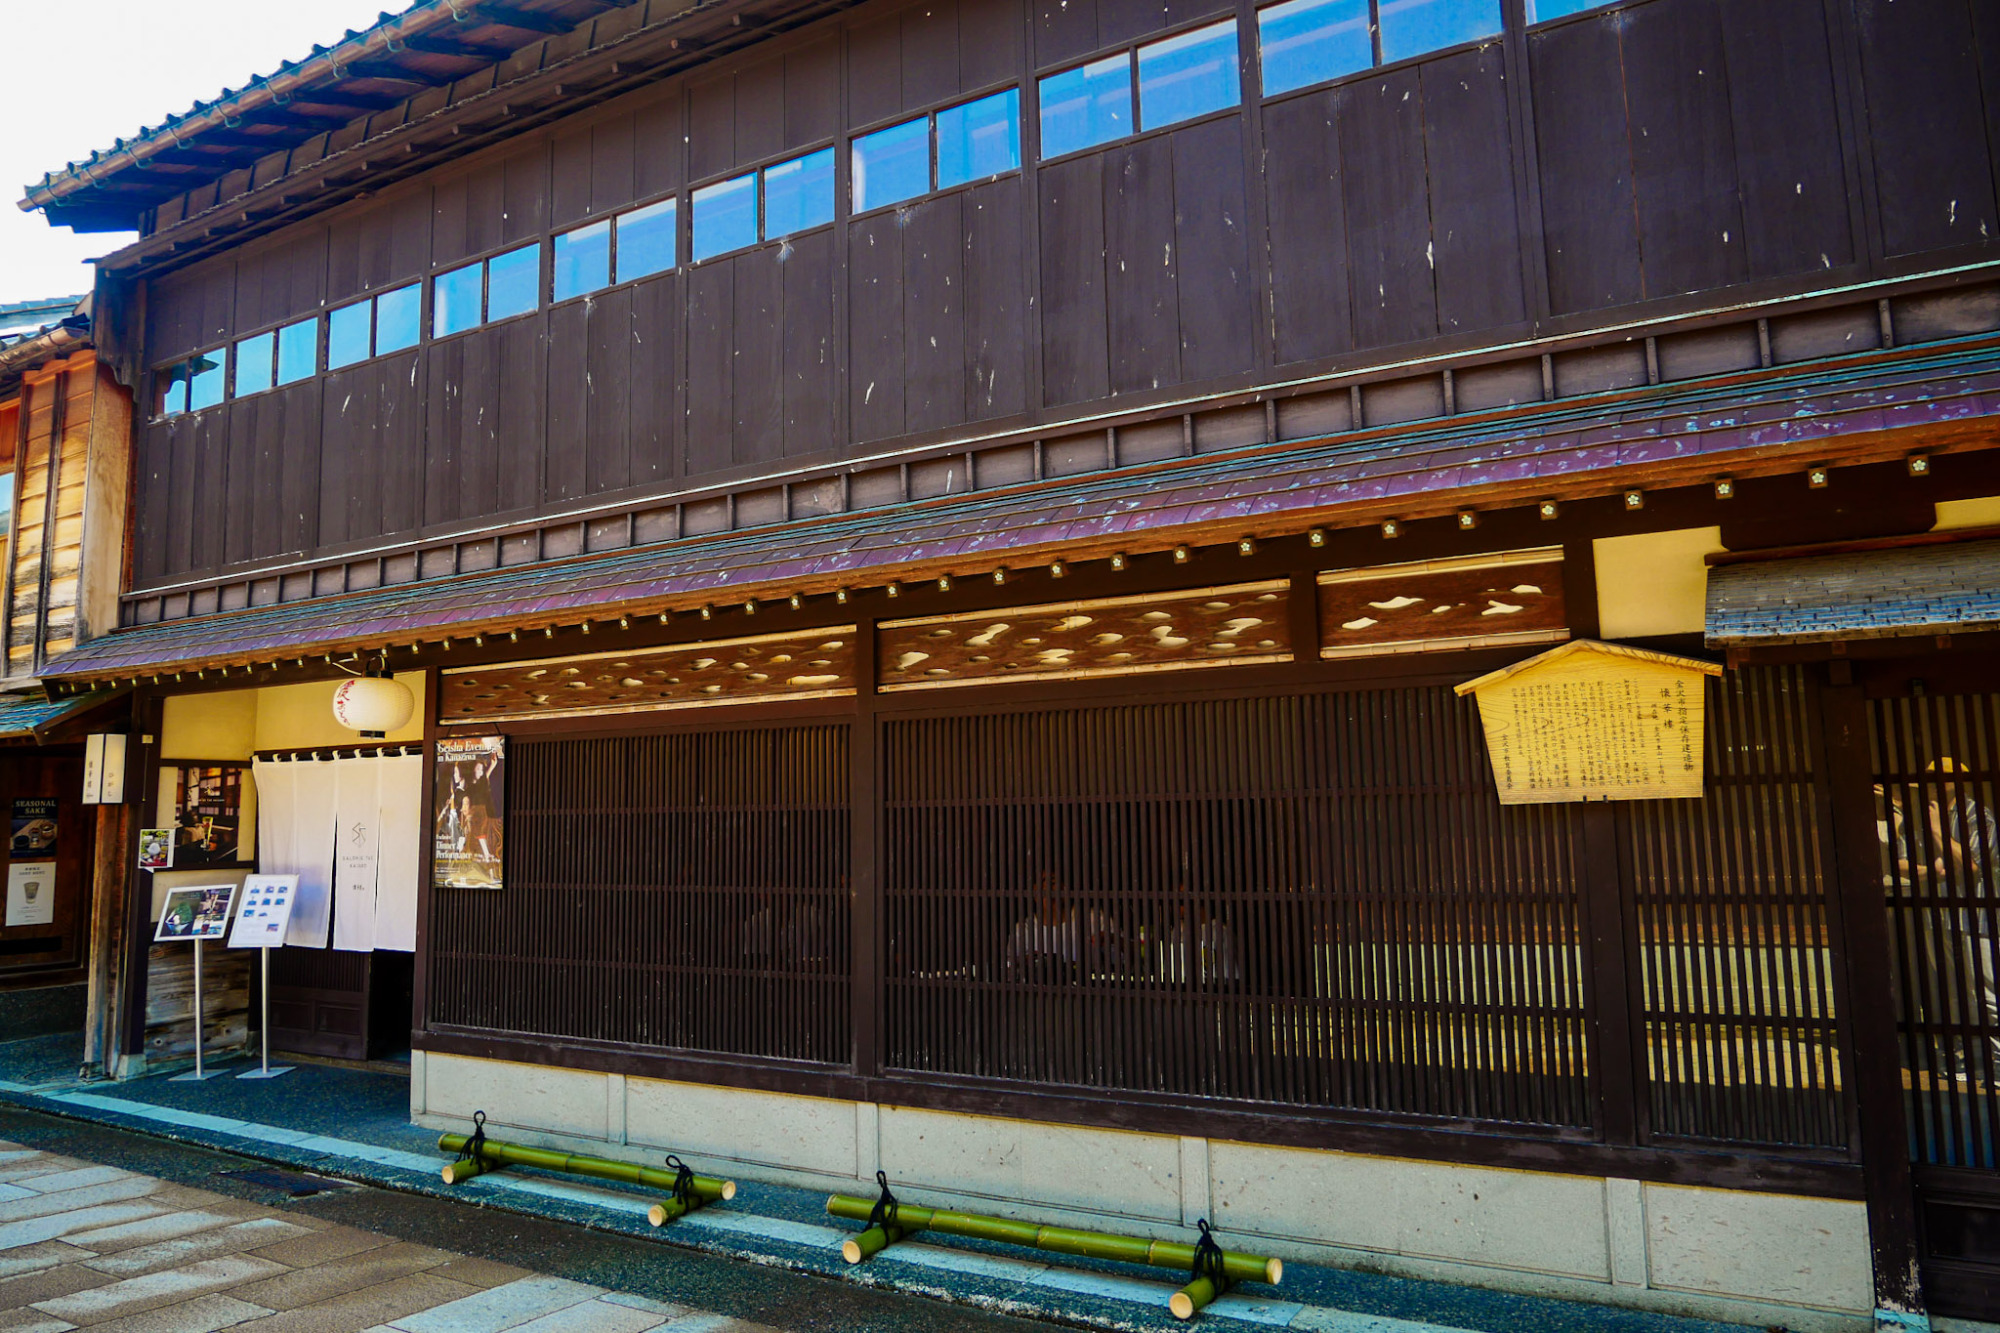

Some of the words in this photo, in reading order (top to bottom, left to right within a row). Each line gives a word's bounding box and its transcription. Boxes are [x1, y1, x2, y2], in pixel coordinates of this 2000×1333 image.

[1674, 680, 1694, 771] 金沢市指定保存建造物
[436, 741, 464, 753] Geisha
[445, 753, 476, 762] Kanazawa
[436, 841, 456, 850] Dinner
[436, 850, 472, 859] Performance
